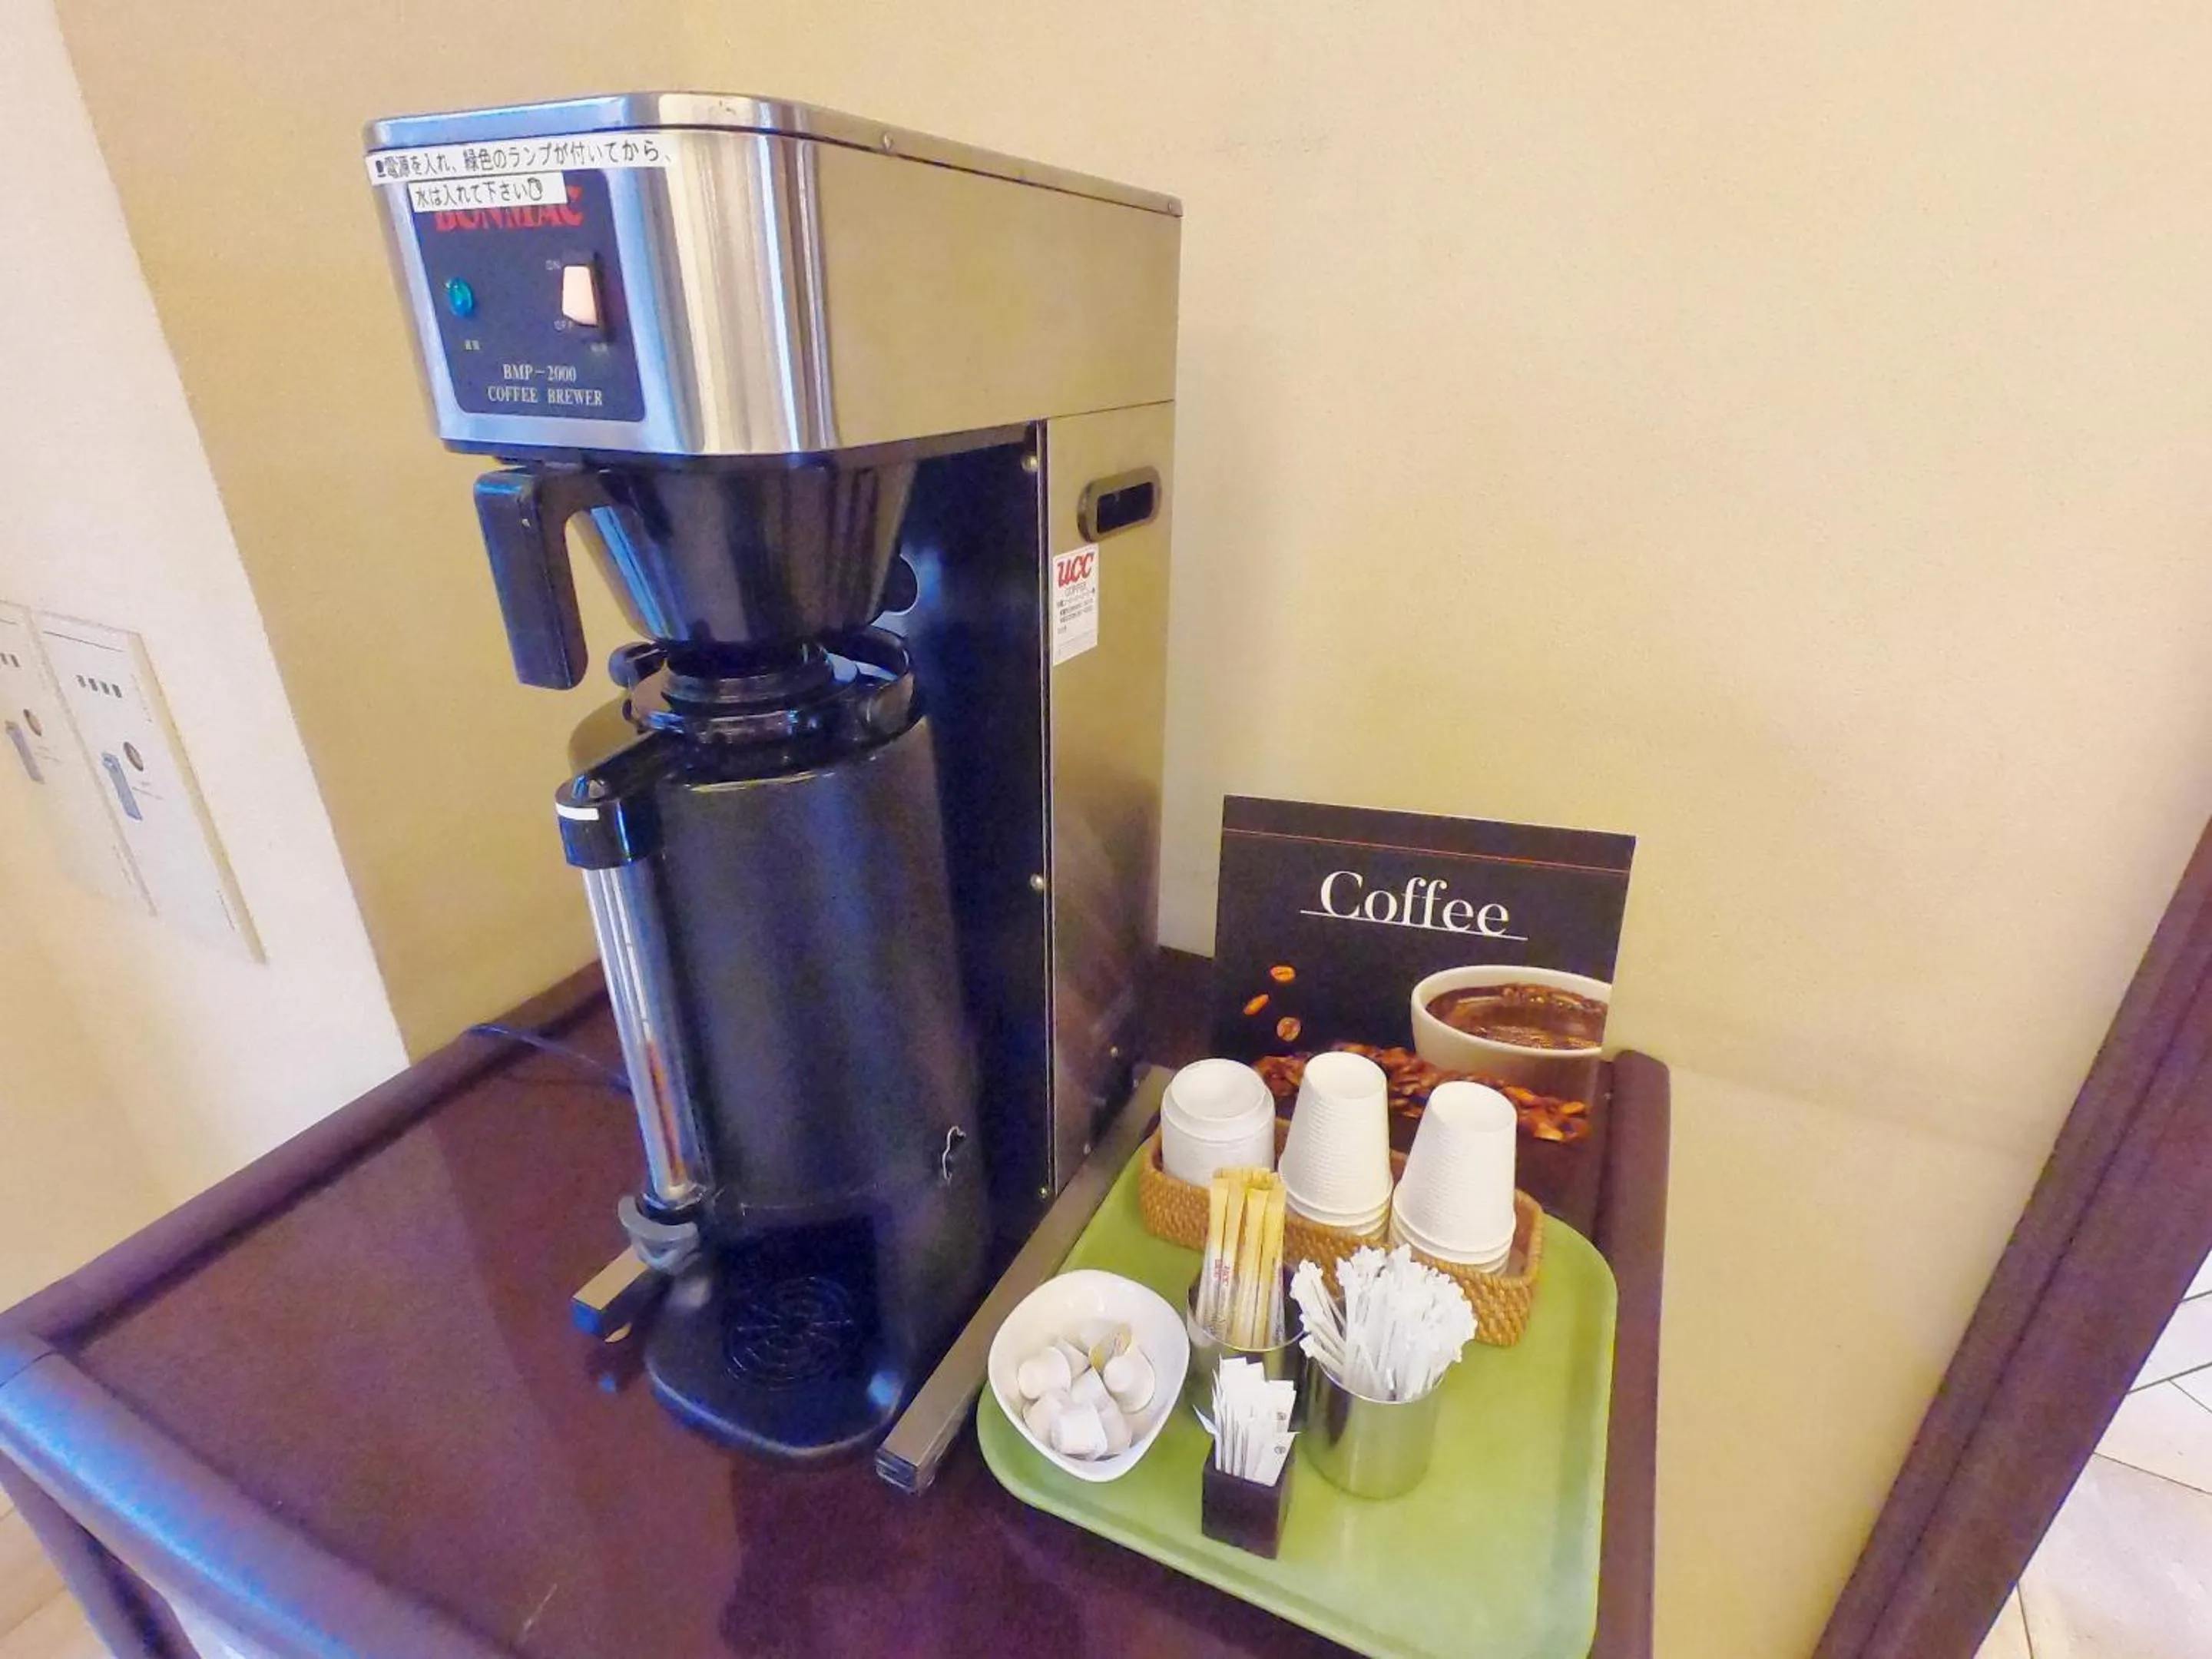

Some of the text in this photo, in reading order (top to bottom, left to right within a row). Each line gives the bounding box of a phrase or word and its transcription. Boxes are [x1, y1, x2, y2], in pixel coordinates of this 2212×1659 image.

[488, 386, 602, 406] COFFEE BREWER
[1320, 870, 1509, 936] Coffee
